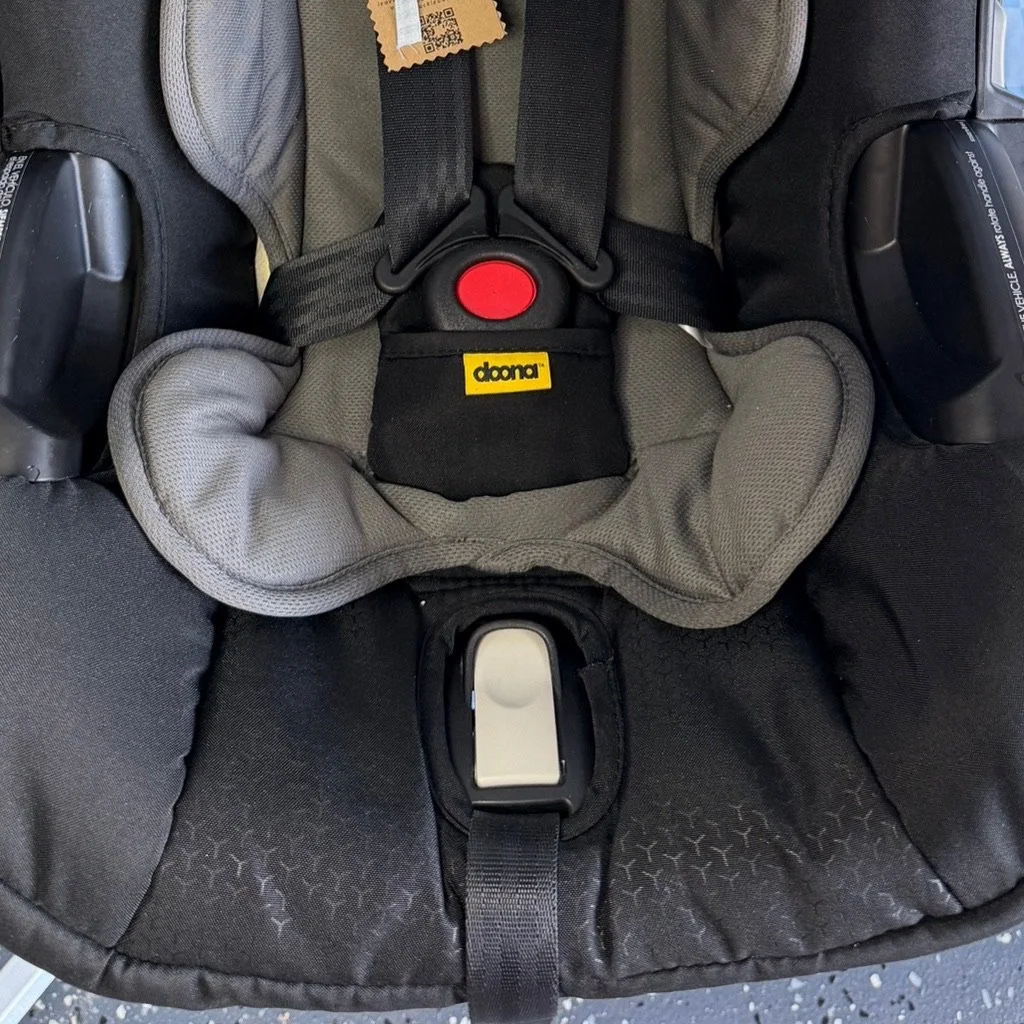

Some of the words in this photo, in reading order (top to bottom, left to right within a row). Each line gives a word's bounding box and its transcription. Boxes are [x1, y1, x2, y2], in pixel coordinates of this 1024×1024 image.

[977, 178, 994, 207] handle
[988, 208, 1003, 234] rotate
[995, 234, 1015, 270] ALWAYS
[1007, 271, 1024, 313] VEHICLE
[473, 361, 539, 383] doona
